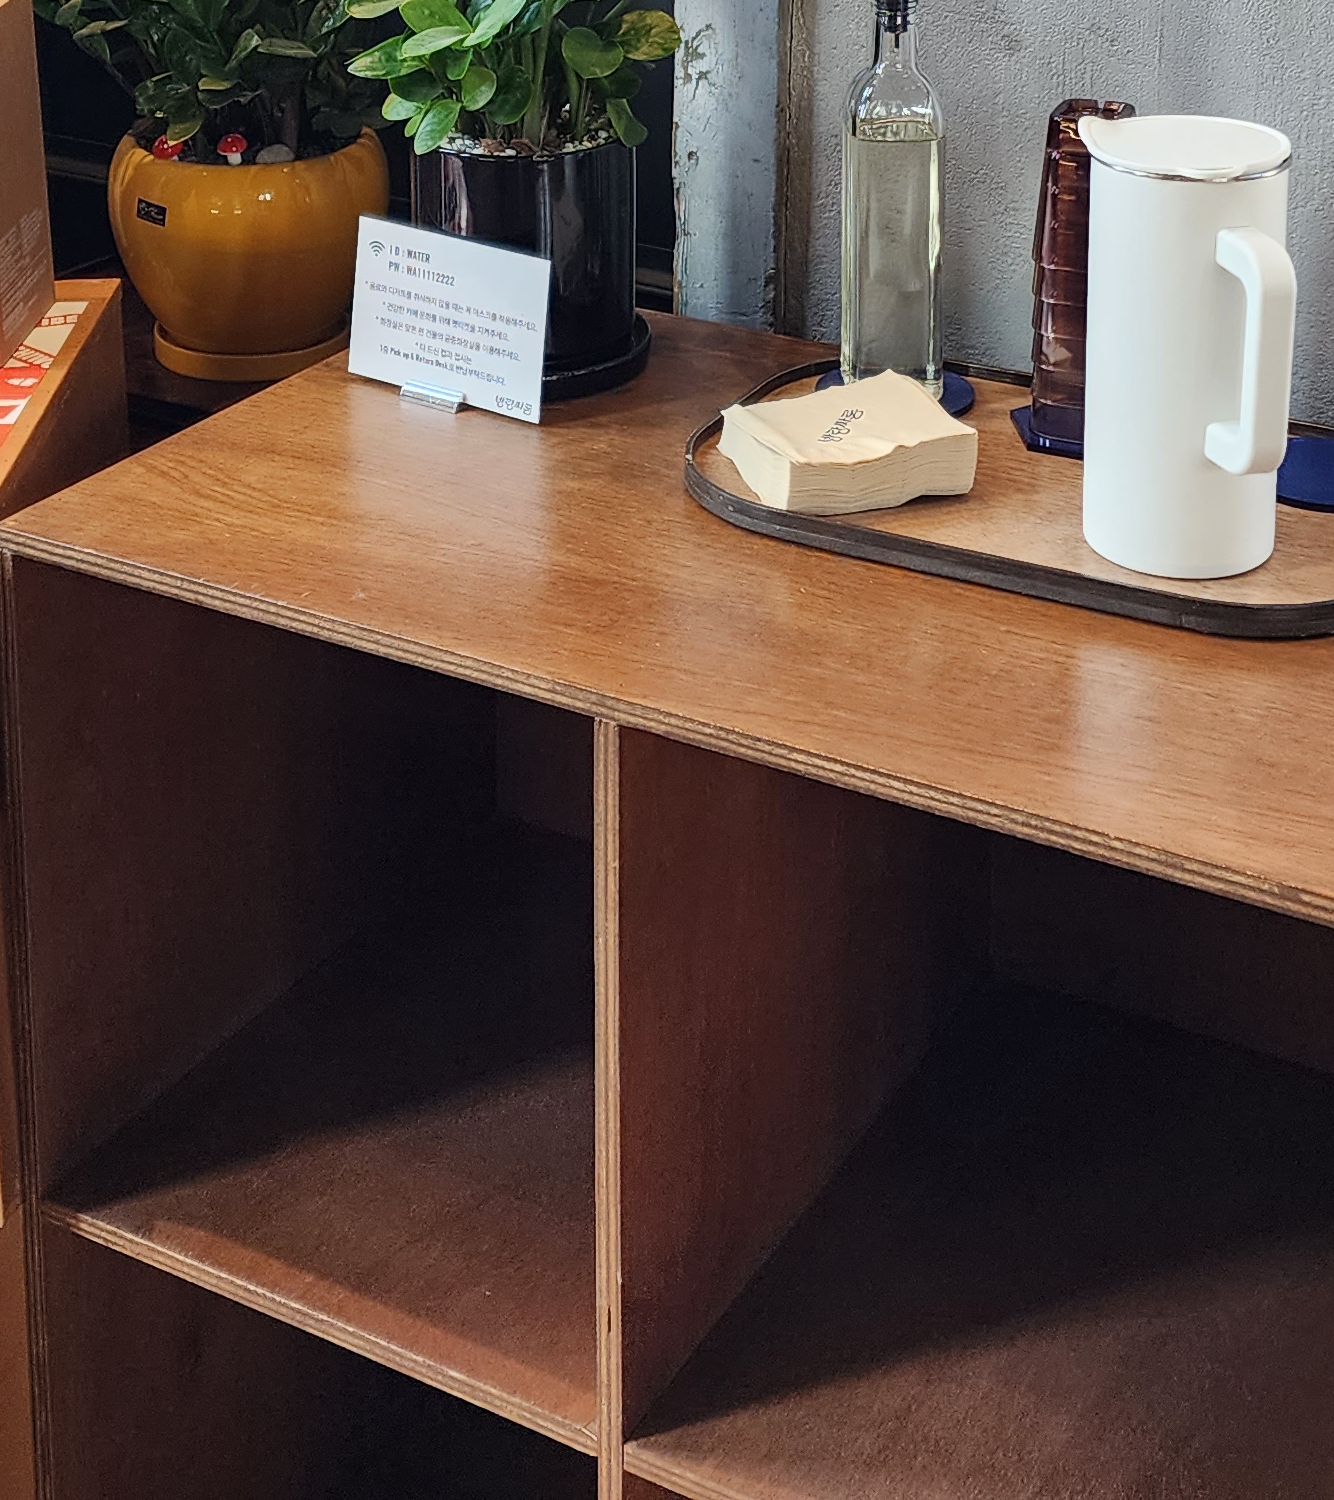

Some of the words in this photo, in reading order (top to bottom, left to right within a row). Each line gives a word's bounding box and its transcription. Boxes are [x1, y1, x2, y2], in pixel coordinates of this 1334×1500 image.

[406, 248, 431, 264] WATER
[388, 260, 400, 273] PW
[406, 264, 456, 287] WA11112222
